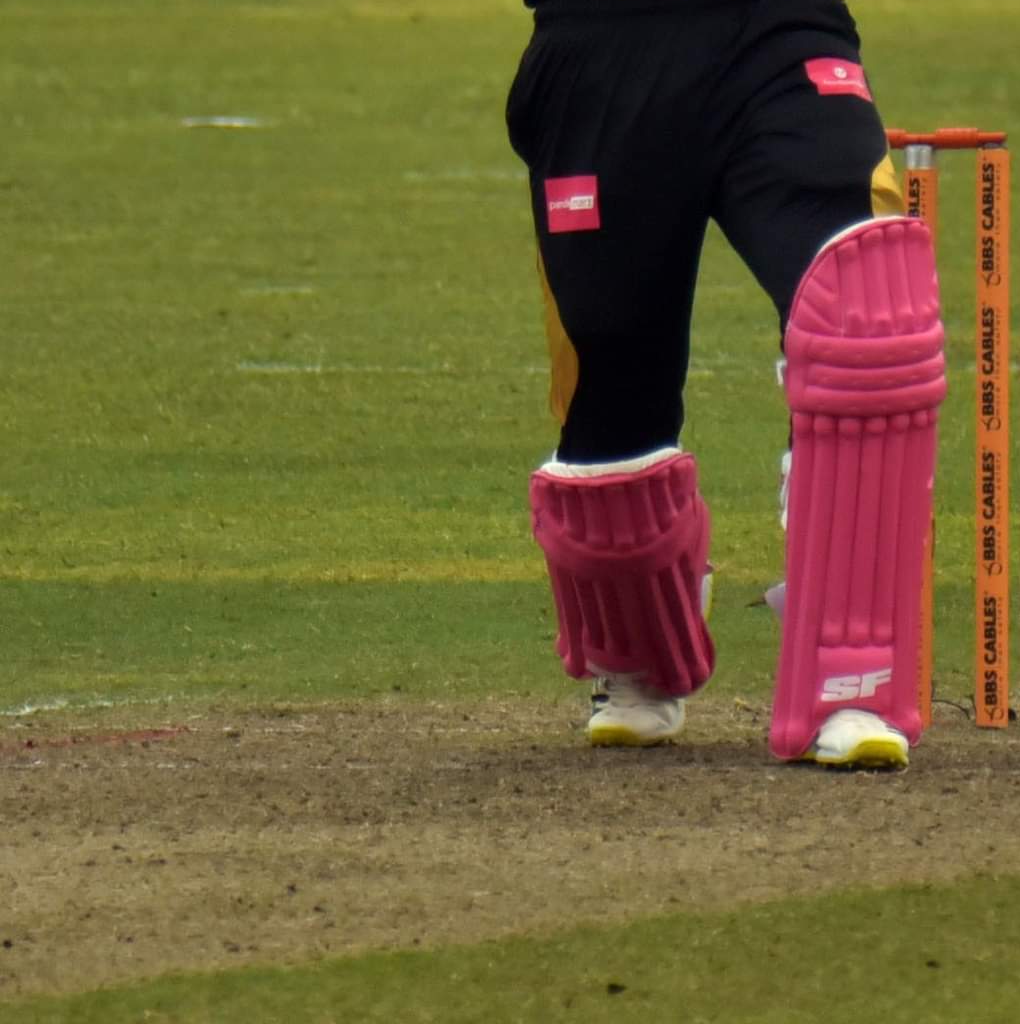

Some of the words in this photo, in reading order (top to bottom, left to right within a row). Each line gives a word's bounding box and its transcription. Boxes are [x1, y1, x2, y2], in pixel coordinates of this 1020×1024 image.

[907, 177, 920, 218] BLES
[982, 163, 994, 231] CABLES
[982, 236, 994, 272] BBS
[982, 307, 994, 375] CABLES
[982, 380, 994, 416] BBS
[982, 451, 995, 520] CABLES
[983, 525, 995, 561] BBS
[983, 596, 997, 665] CABLES
[821, 667, 892, 702] SF
[984, 669, 997, 705] BBS
